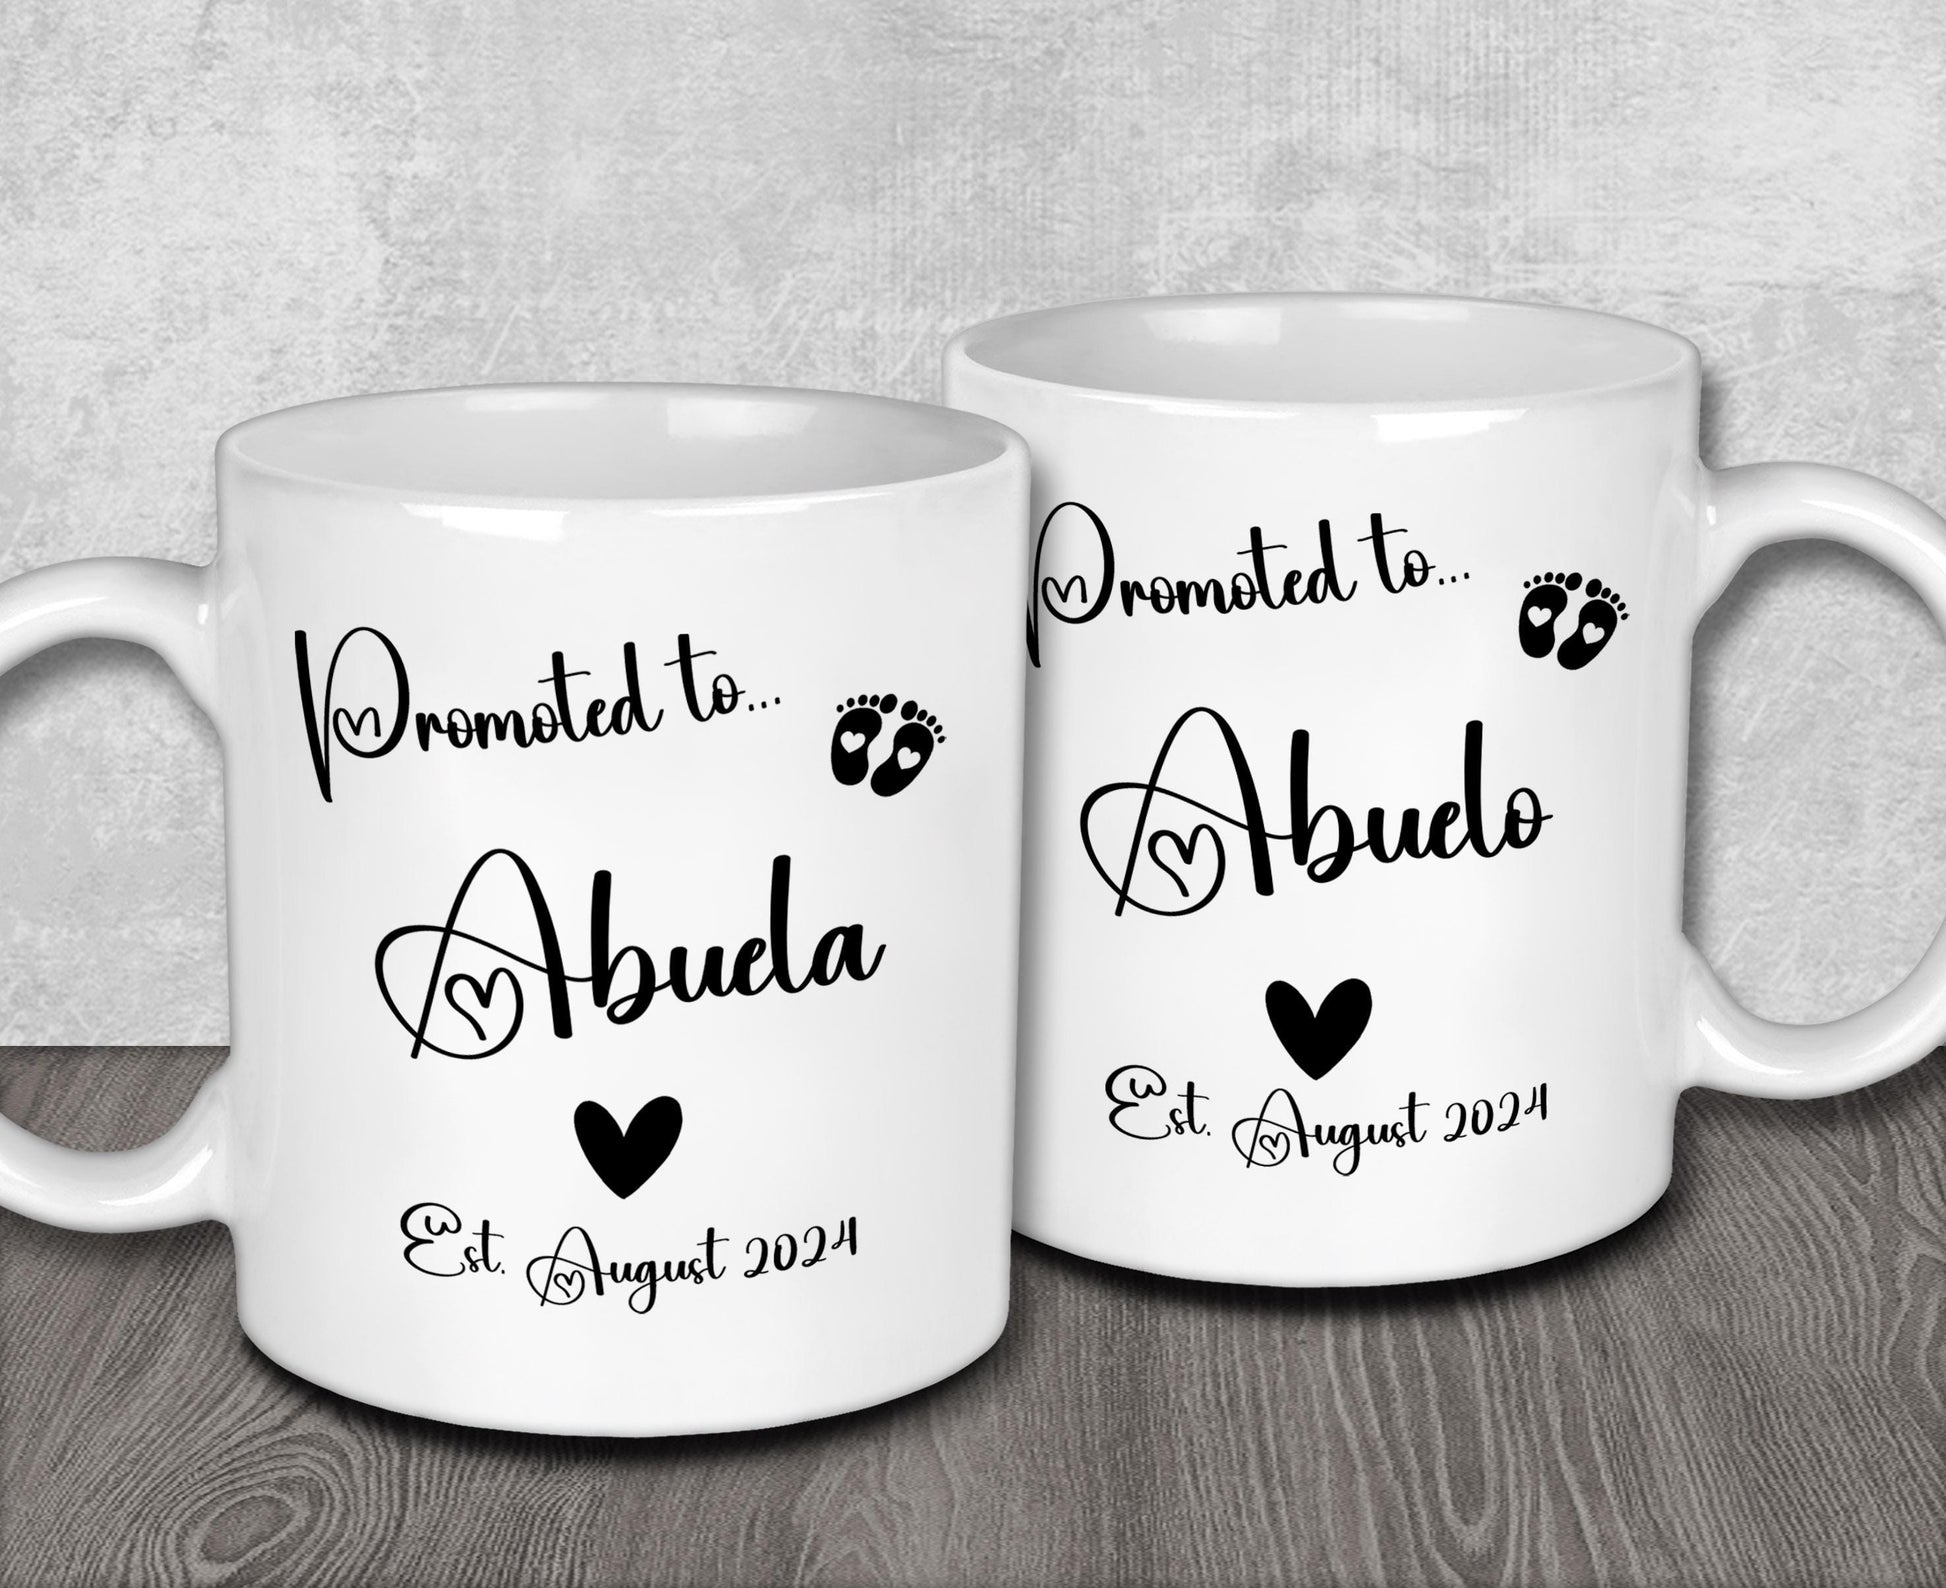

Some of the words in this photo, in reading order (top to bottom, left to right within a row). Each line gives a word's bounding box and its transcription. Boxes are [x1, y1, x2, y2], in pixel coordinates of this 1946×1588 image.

[1026, 502, 1358, 668] Promoted
[1357, 512, 1471, 594] to...
[294, 626, 665, 804] Promoted
[663, 633, 782, 723] to...
[1079, 706, 1554, 917] Abuelo
[374, 848, 887, 1060] Abuela
[1104, 1064, 1211, 1141] Est.
[1231, 1087, 1431, 1177] August
[1443, 1082, 1549, 1143] 2024
[400, 1202, 506, 1278] Est.
[525, 1226, 730, 1315] August
[743, 1216, 858, 1279] 2024
